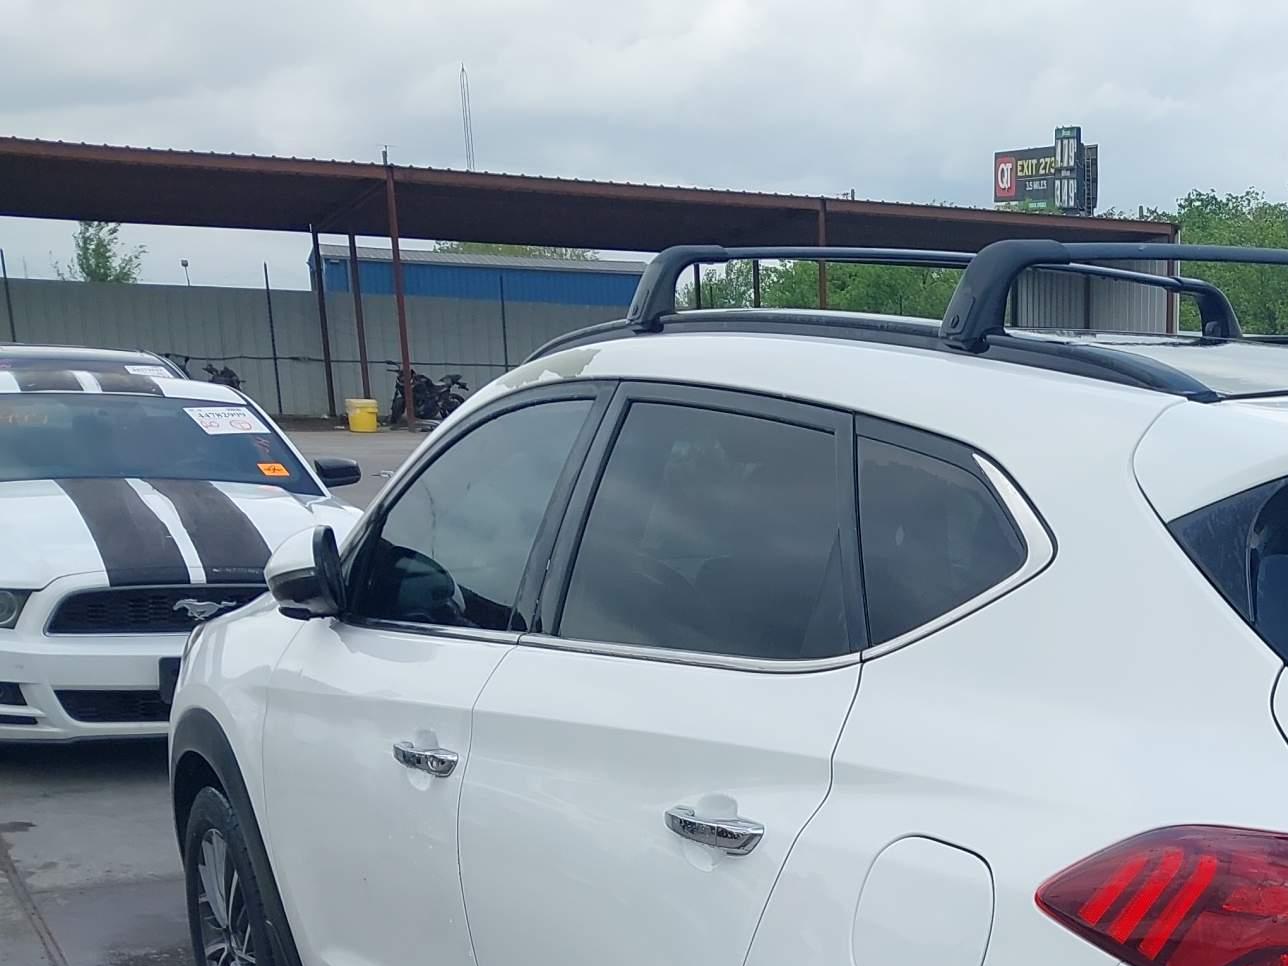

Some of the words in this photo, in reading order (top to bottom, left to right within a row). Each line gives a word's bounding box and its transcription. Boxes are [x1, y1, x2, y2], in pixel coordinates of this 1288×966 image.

[998, 162, 1013, 190] QT
[1017, 159, 1037, 176] EXIT
[1039, 157, 1055, 174] 273
